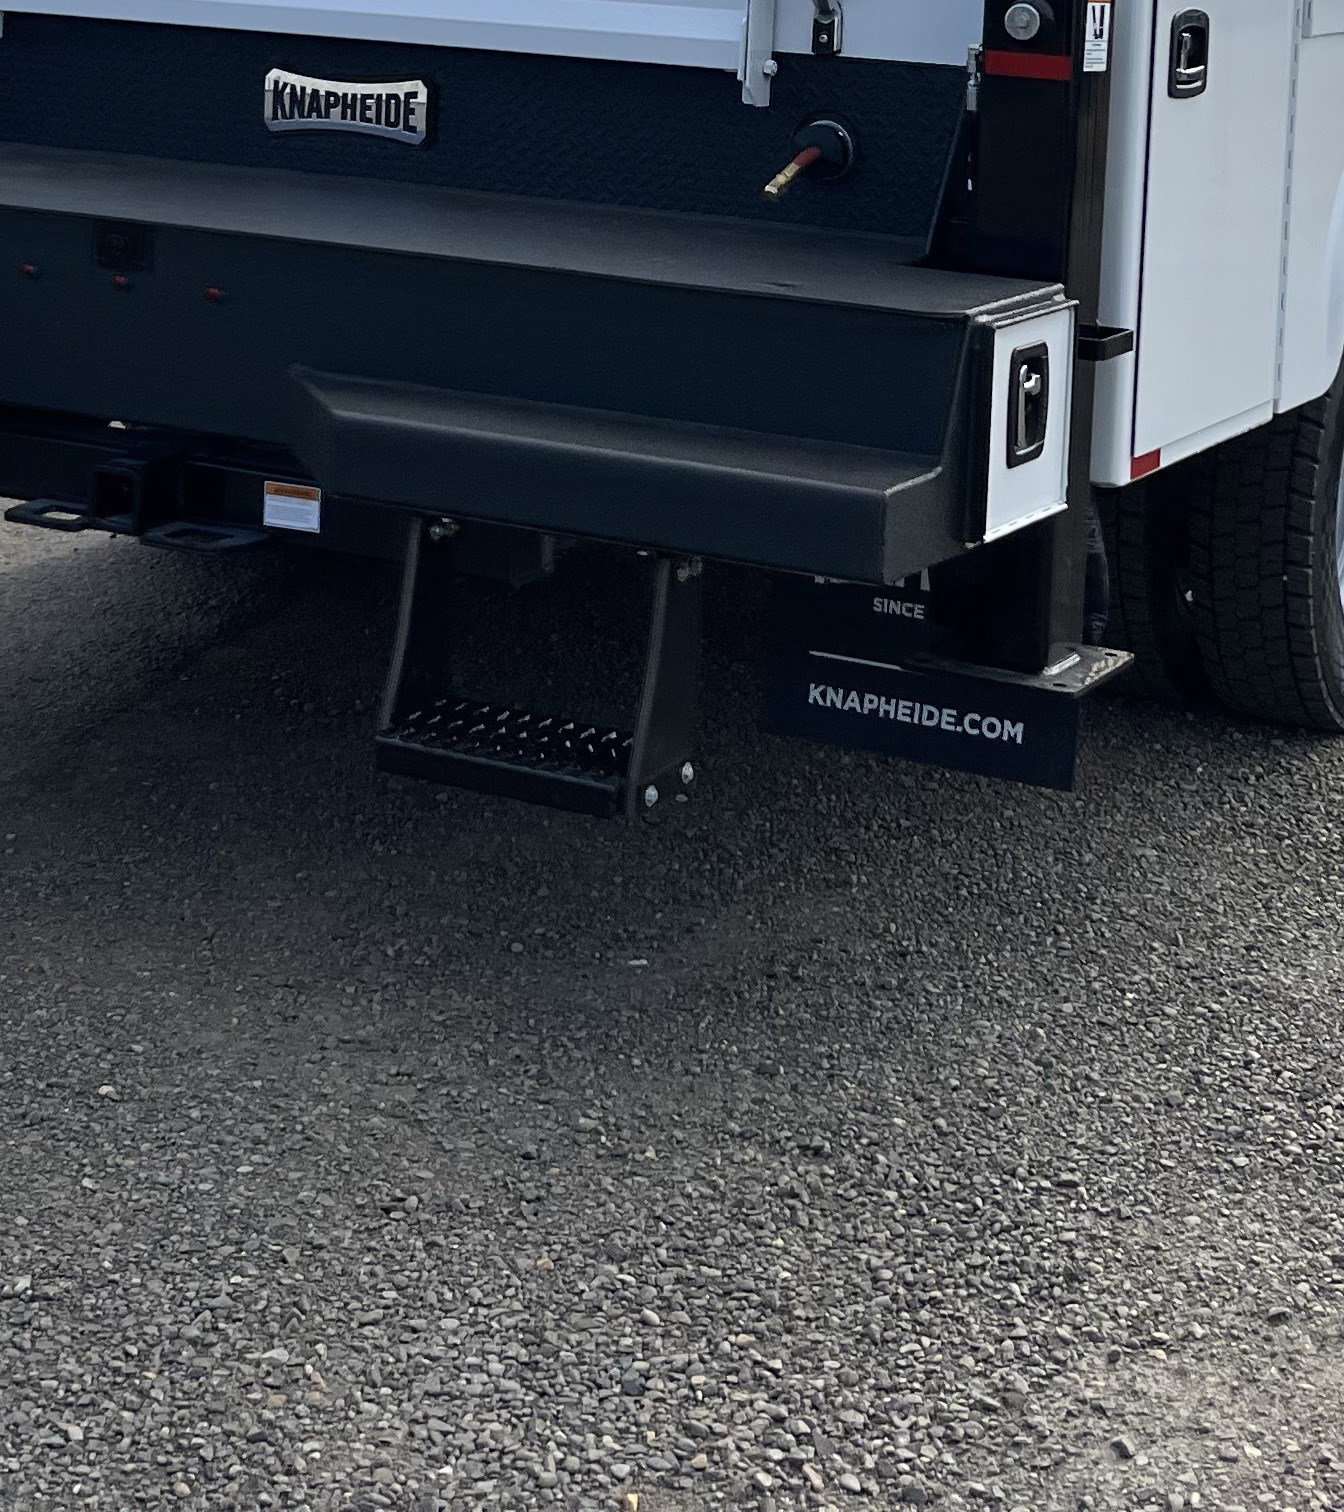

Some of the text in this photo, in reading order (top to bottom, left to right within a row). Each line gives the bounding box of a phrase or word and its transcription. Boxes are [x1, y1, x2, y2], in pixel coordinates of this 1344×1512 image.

[271, 79, 419, 134] KNAPHEIDE
[872, 596, 926, 620] SINCE
[807, 682, 1025, 745] KNAPHEIDE.COM
